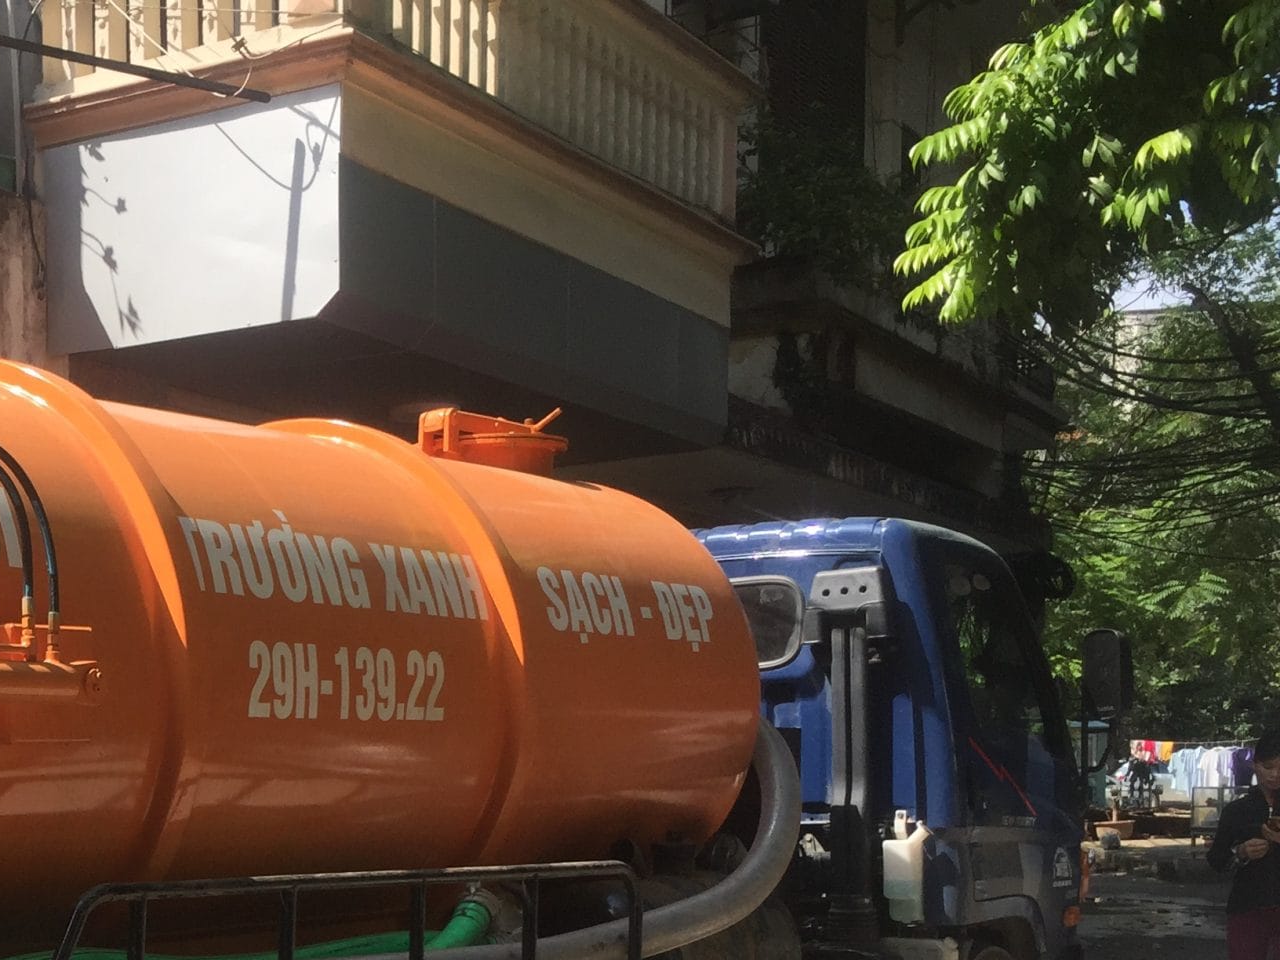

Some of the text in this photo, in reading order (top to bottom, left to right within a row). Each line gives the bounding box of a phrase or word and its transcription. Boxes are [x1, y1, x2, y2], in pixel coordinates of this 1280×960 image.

[176, 509, 371, 609] TRƯỜNG
[368, 543, 488, 620] XANH
[536, 566, 636, 644] SẠCH
[651, 580, 714, 653] ĐẸP
[247, 640, 446, 722] 29H-139.22
